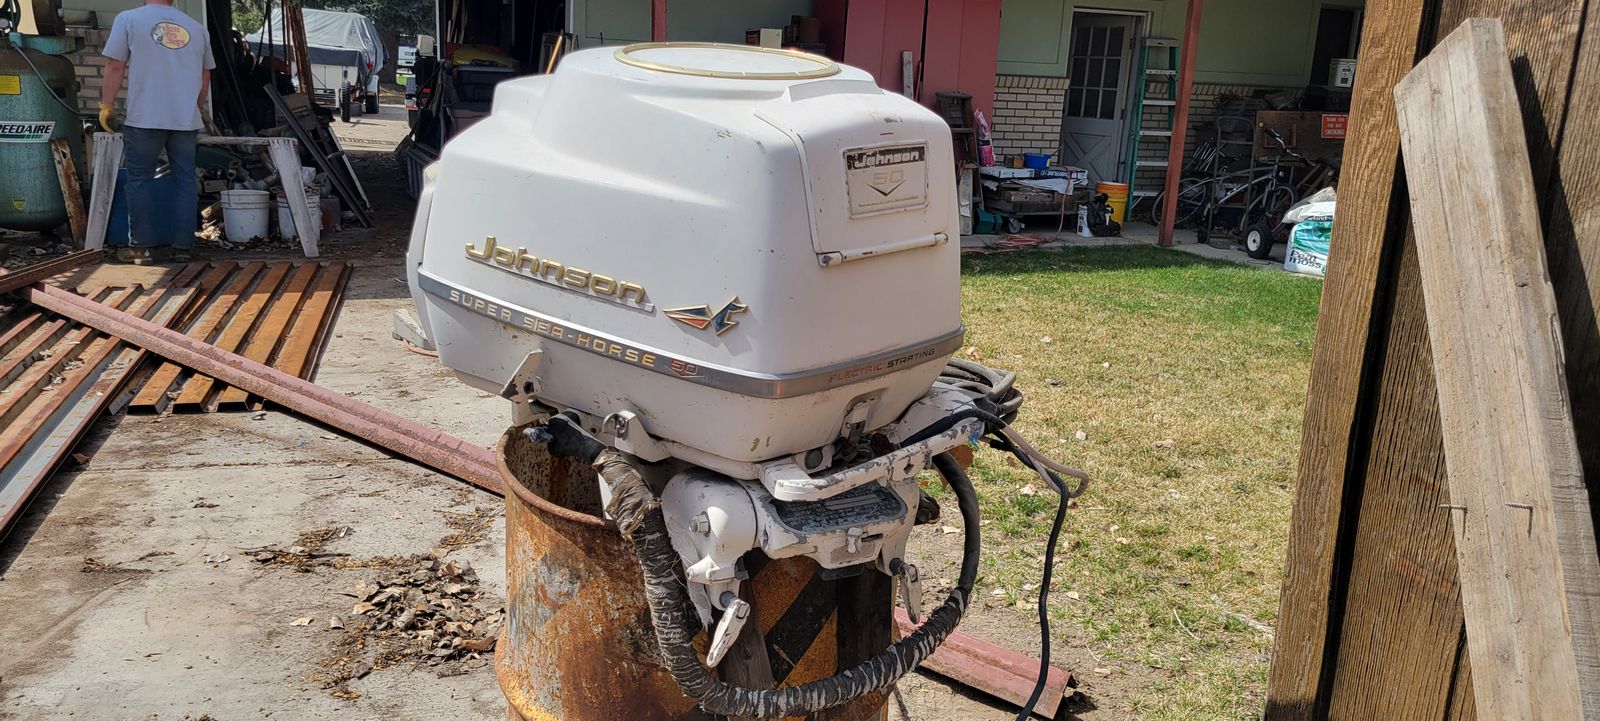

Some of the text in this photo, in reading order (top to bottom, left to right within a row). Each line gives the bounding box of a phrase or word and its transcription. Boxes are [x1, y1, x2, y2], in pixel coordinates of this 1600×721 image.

[854, 150, 920, 168] Johnson
[873, 169, 904, 186] 50
[1289, 256, 1322, 268] moss
[1291, 250, 1317, 262] Peat
[465, 235, 646, 304] Johnson
[449, 290, 512, 322] SUPER
[671, 359, 699, 376] 50
[829, 348, 935, 383] ELECTRIC STARTING
